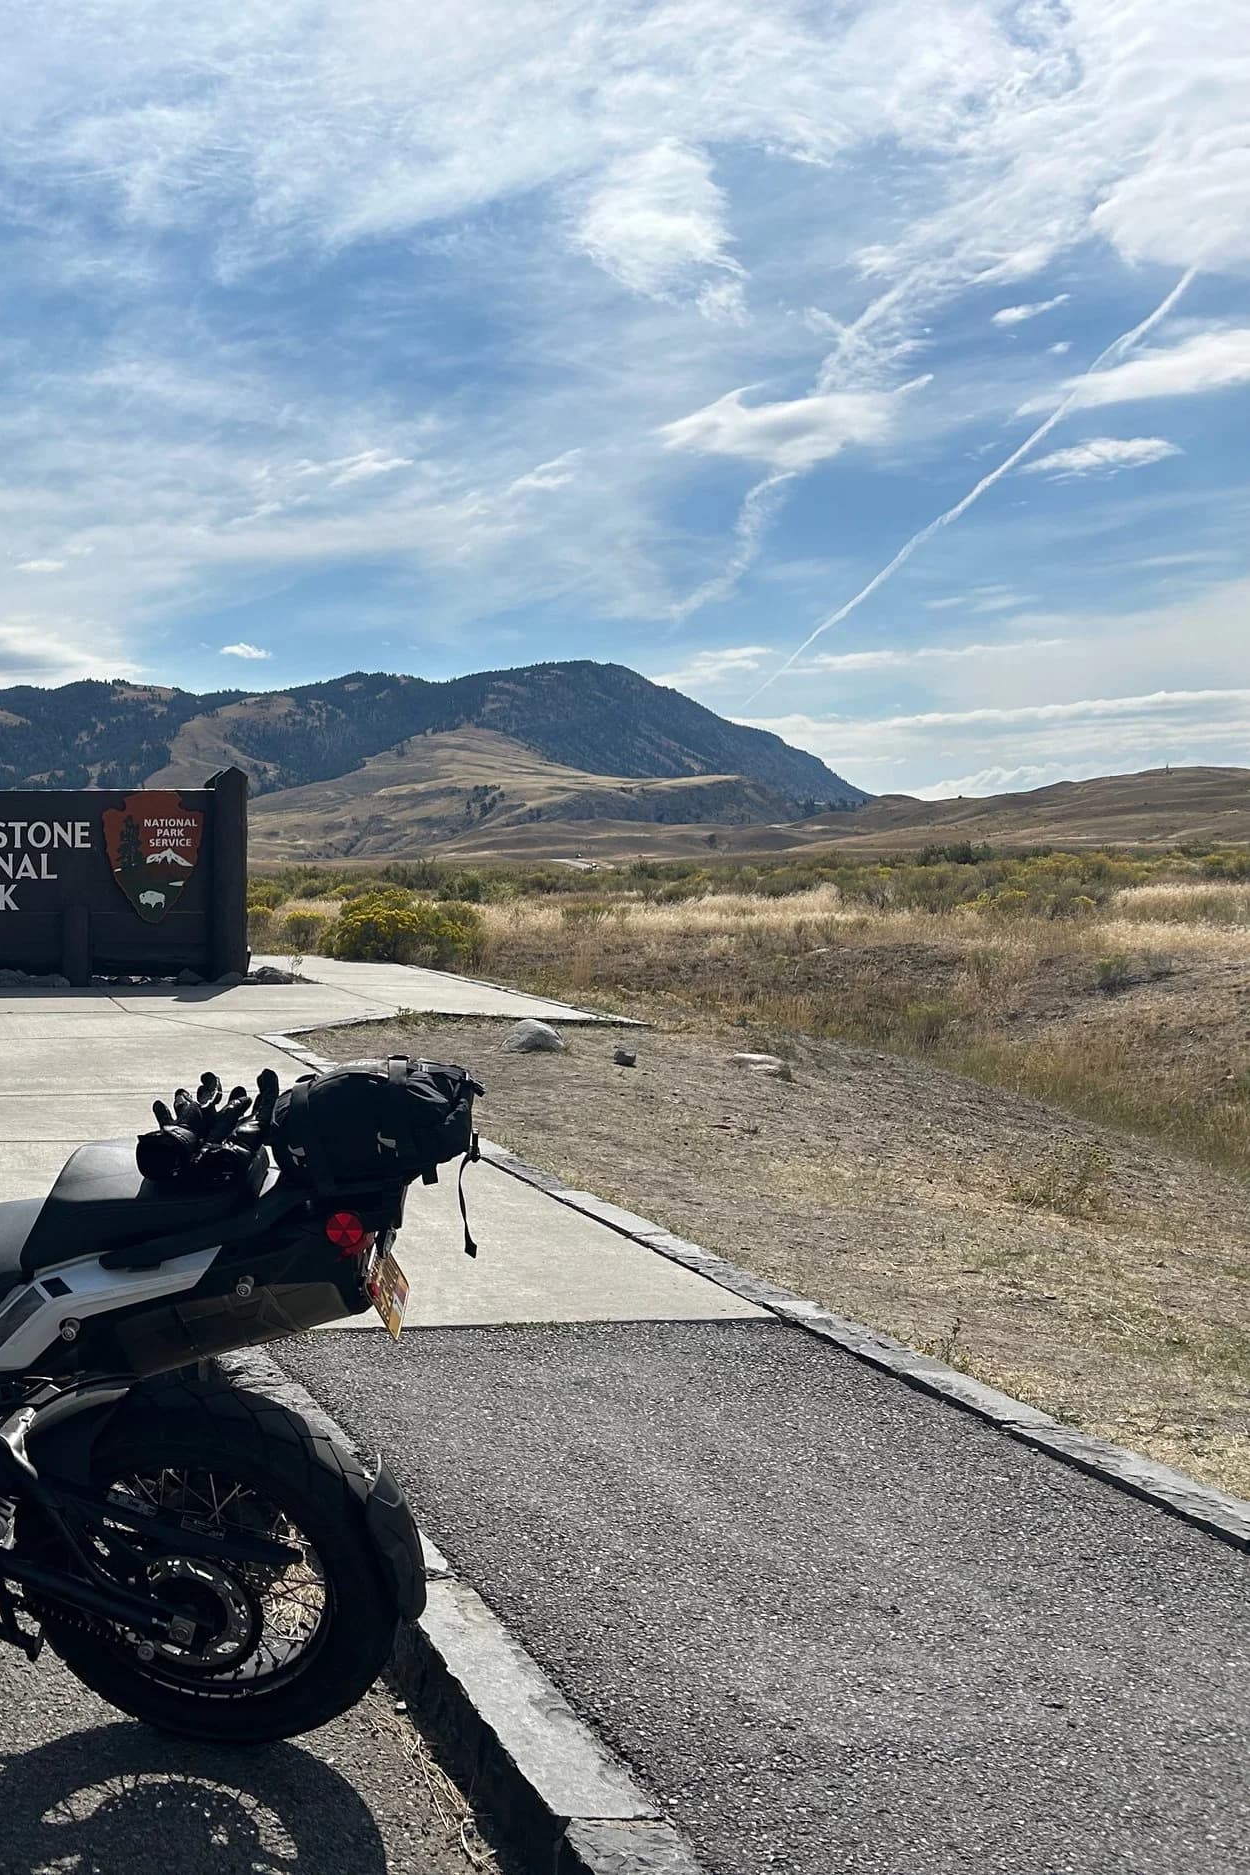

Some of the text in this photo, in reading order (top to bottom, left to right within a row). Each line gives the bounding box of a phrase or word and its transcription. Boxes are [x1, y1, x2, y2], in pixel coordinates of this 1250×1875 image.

[144, 818, 198, 827] NATIONAL
[156, 828, 184, 837] PARK
[149, 838, 192, 847] SERVICE
